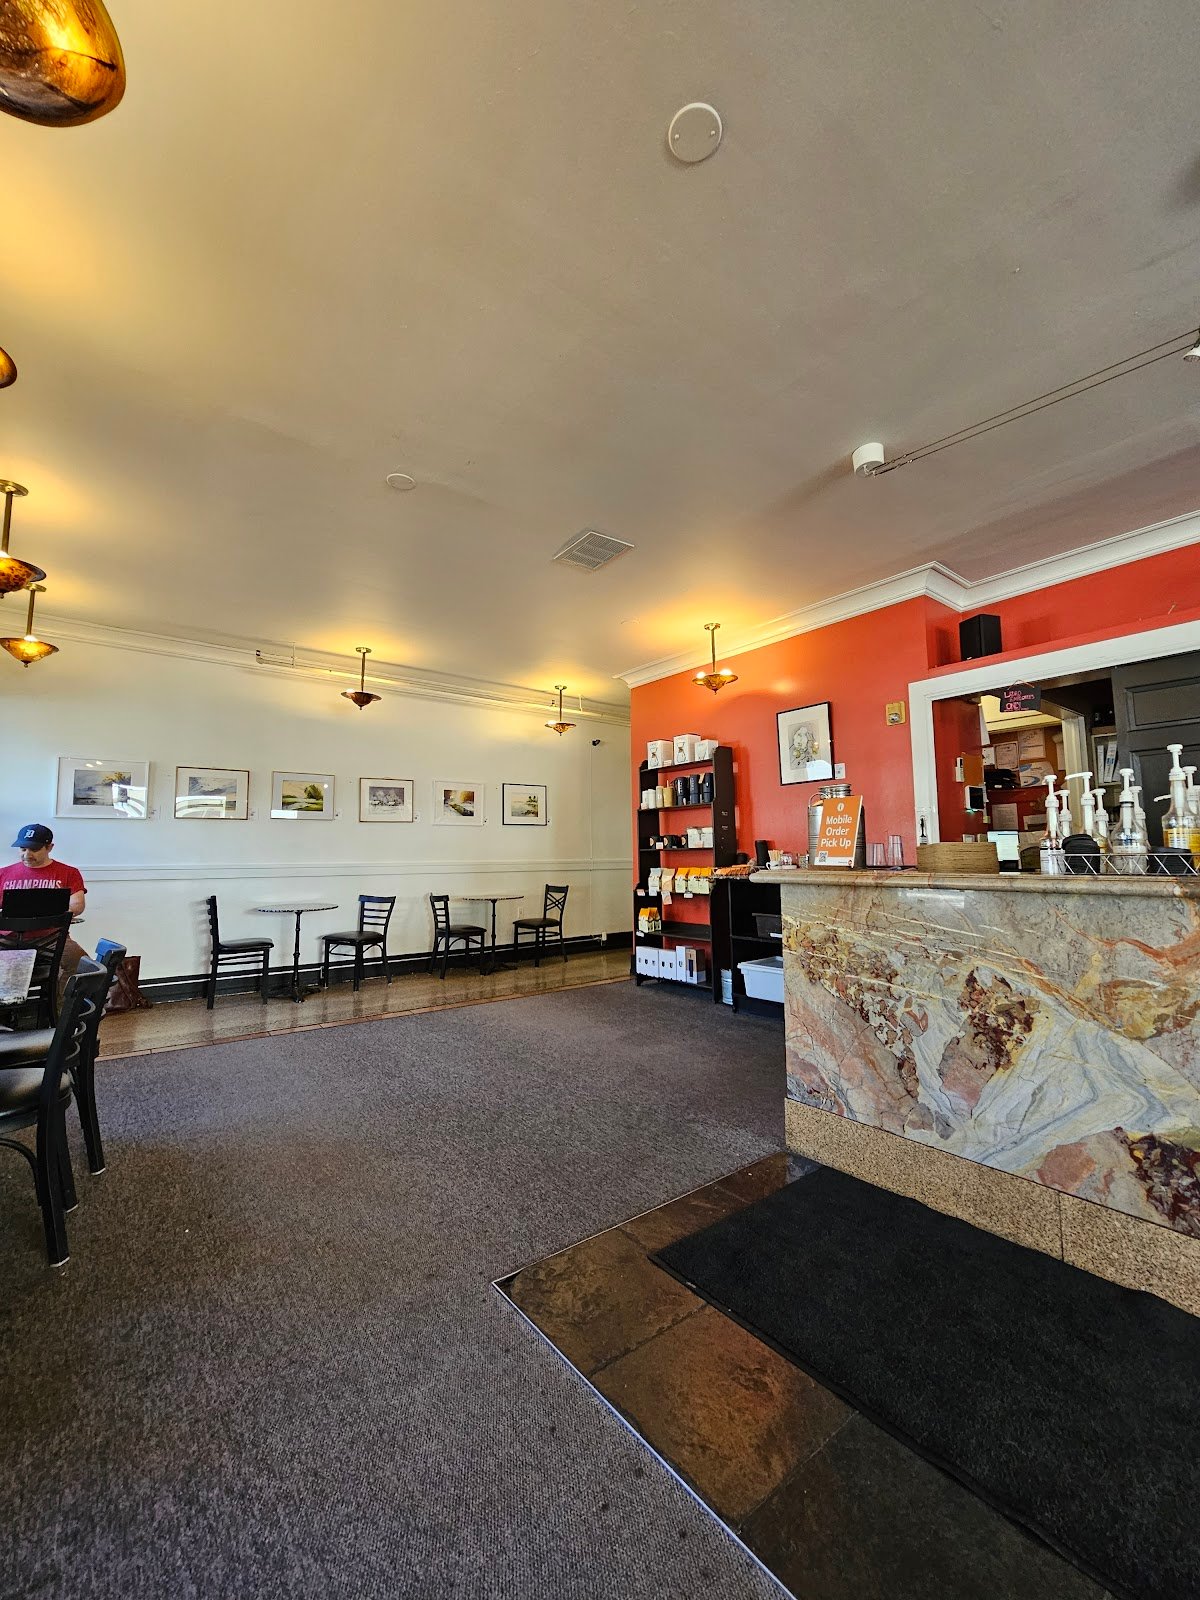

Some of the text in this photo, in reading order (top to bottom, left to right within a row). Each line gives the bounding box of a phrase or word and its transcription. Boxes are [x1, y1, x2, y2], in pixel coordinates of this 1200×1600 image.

[826, 815, 852, 825] Mobile
[826, 827, 849, 836] Order
[821, 838, 852, 849] Pick Up
[3, 879, 62, 890] CHAMPIONS
